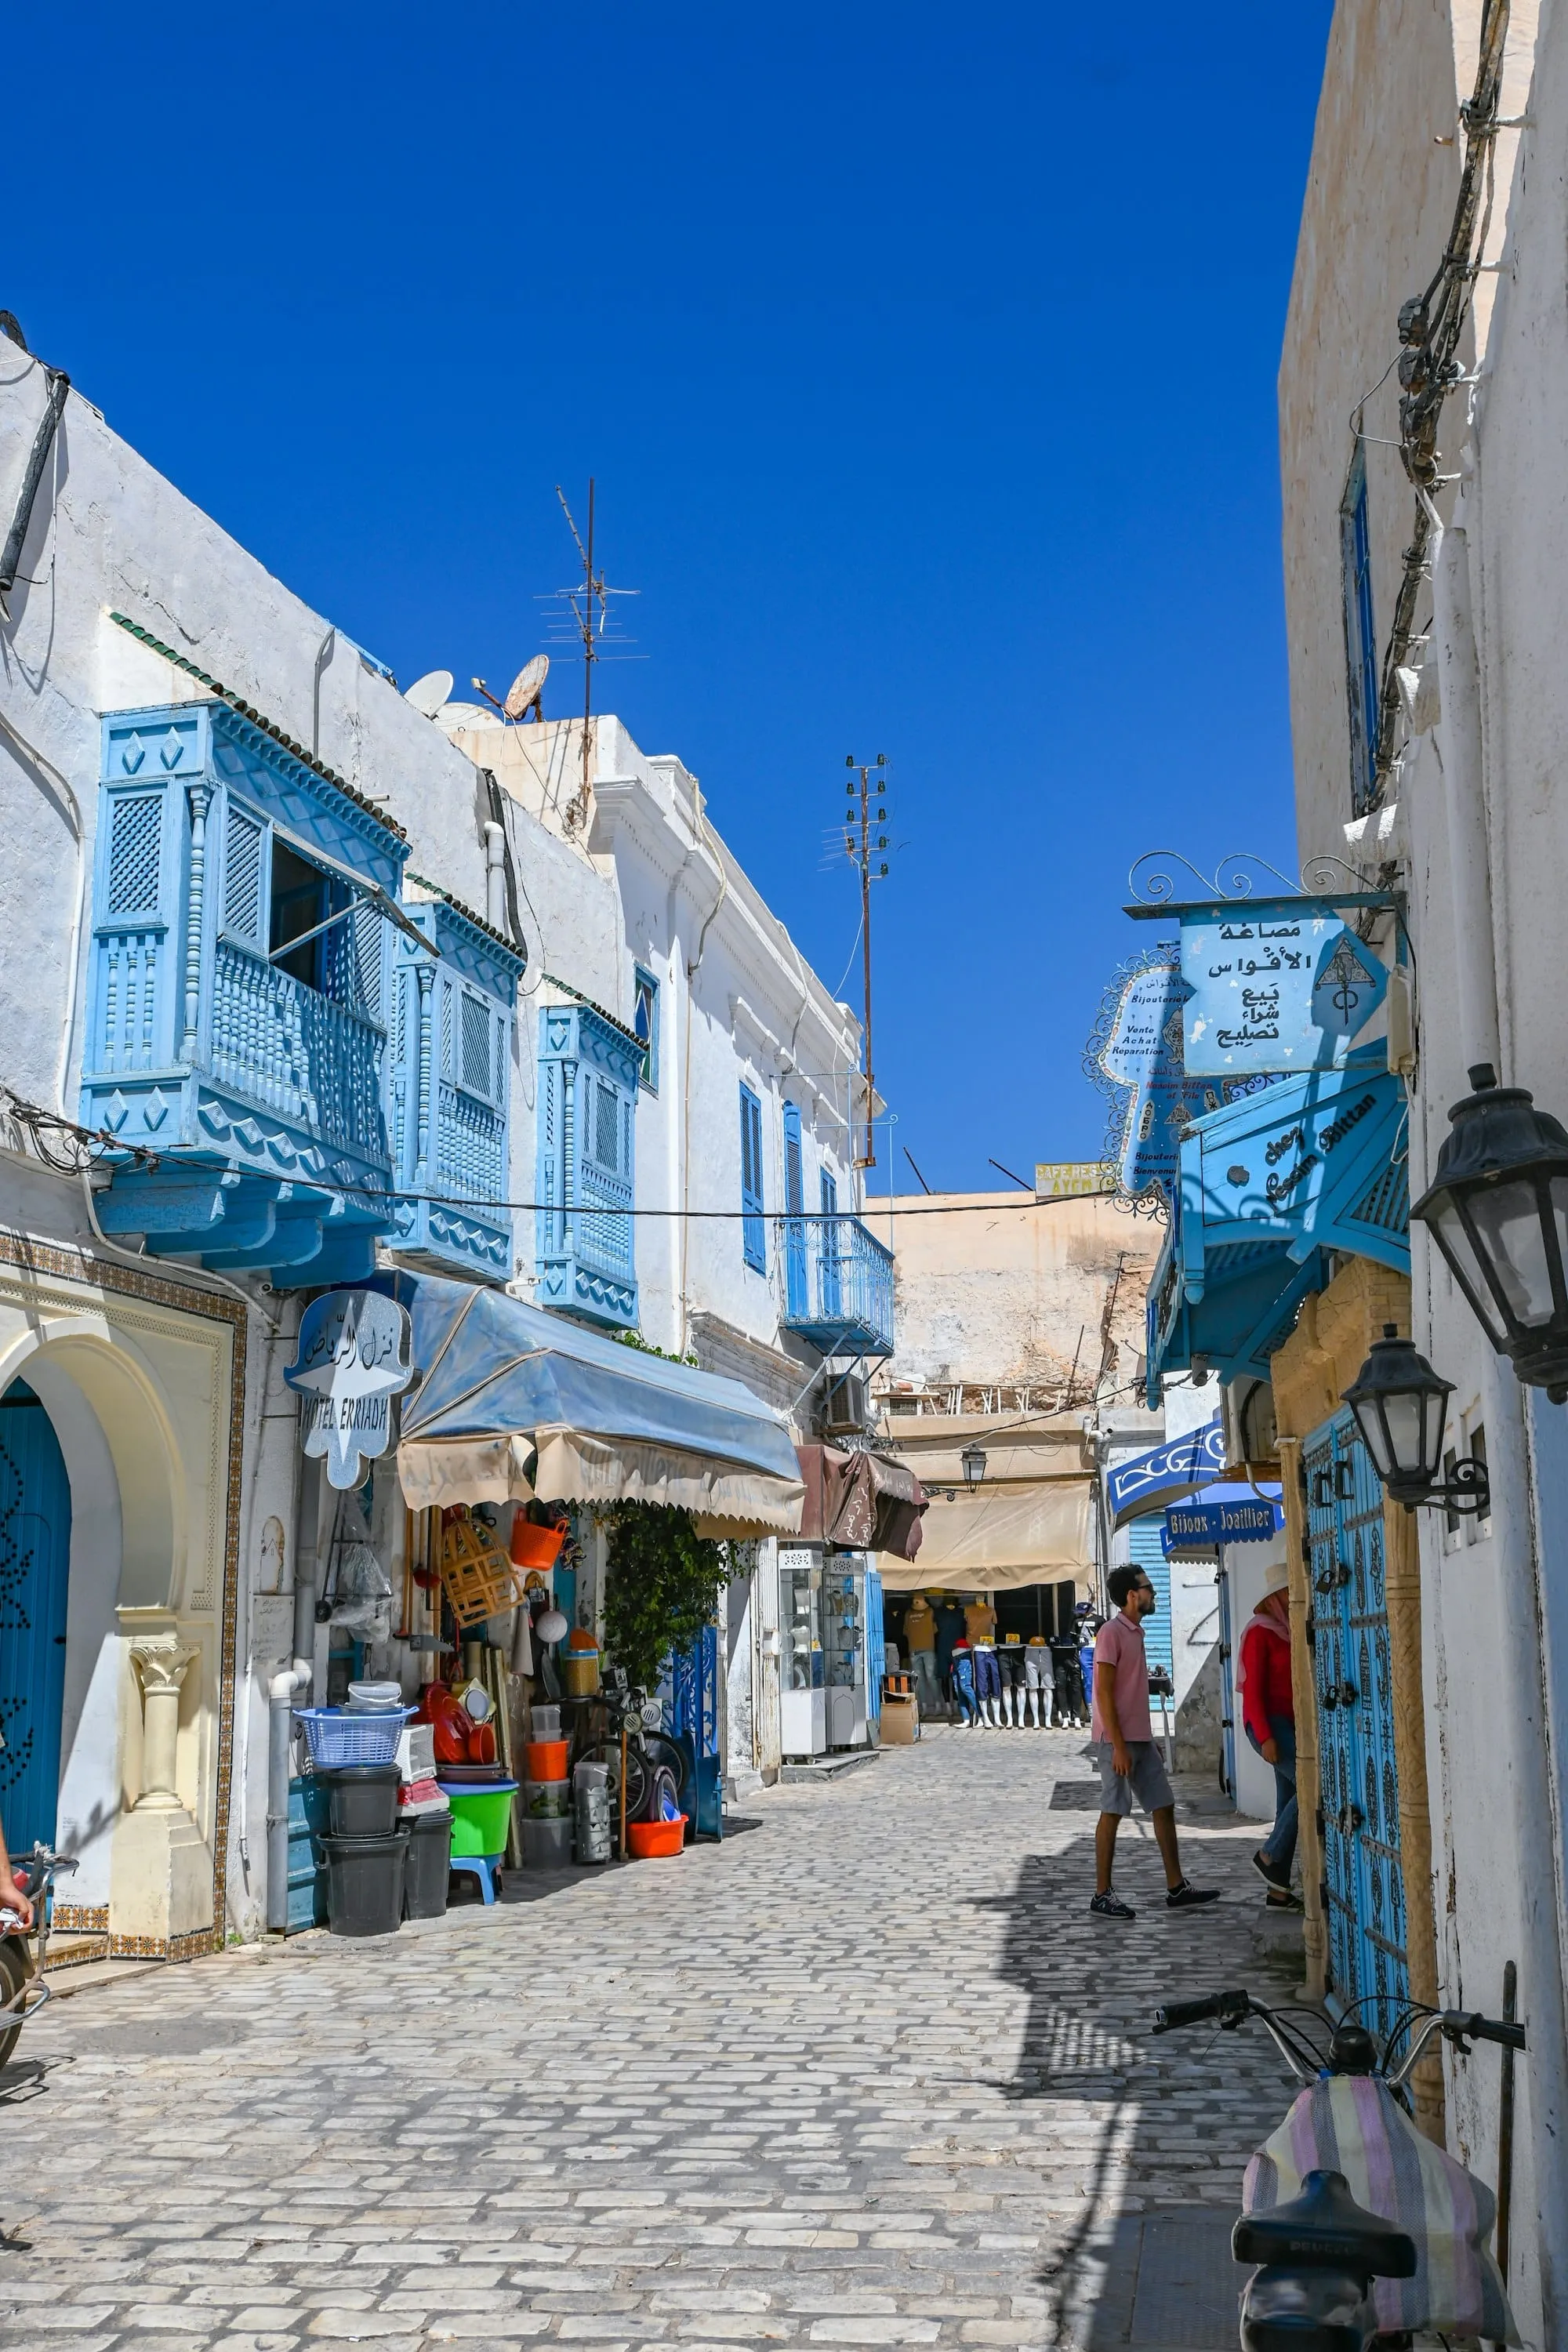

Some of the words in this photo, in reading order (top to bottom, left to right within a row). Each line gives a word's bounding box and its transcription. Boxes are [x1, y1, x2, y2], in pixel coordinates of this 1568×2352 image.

[1127, 1025, 1155, 1034] Vente
[1122, 1036, 1157, 1044] Achat
[1205, 1091, 1218, 1111] ПОЖ
[1134, 1166, 1177, 1175] Bienvenu
[303, 1385, 335, 1430] HÔTEL
[339, 1397, 388, 1431] ERRIADH
[1171, 1513, 1208, 1534] Bijoux
